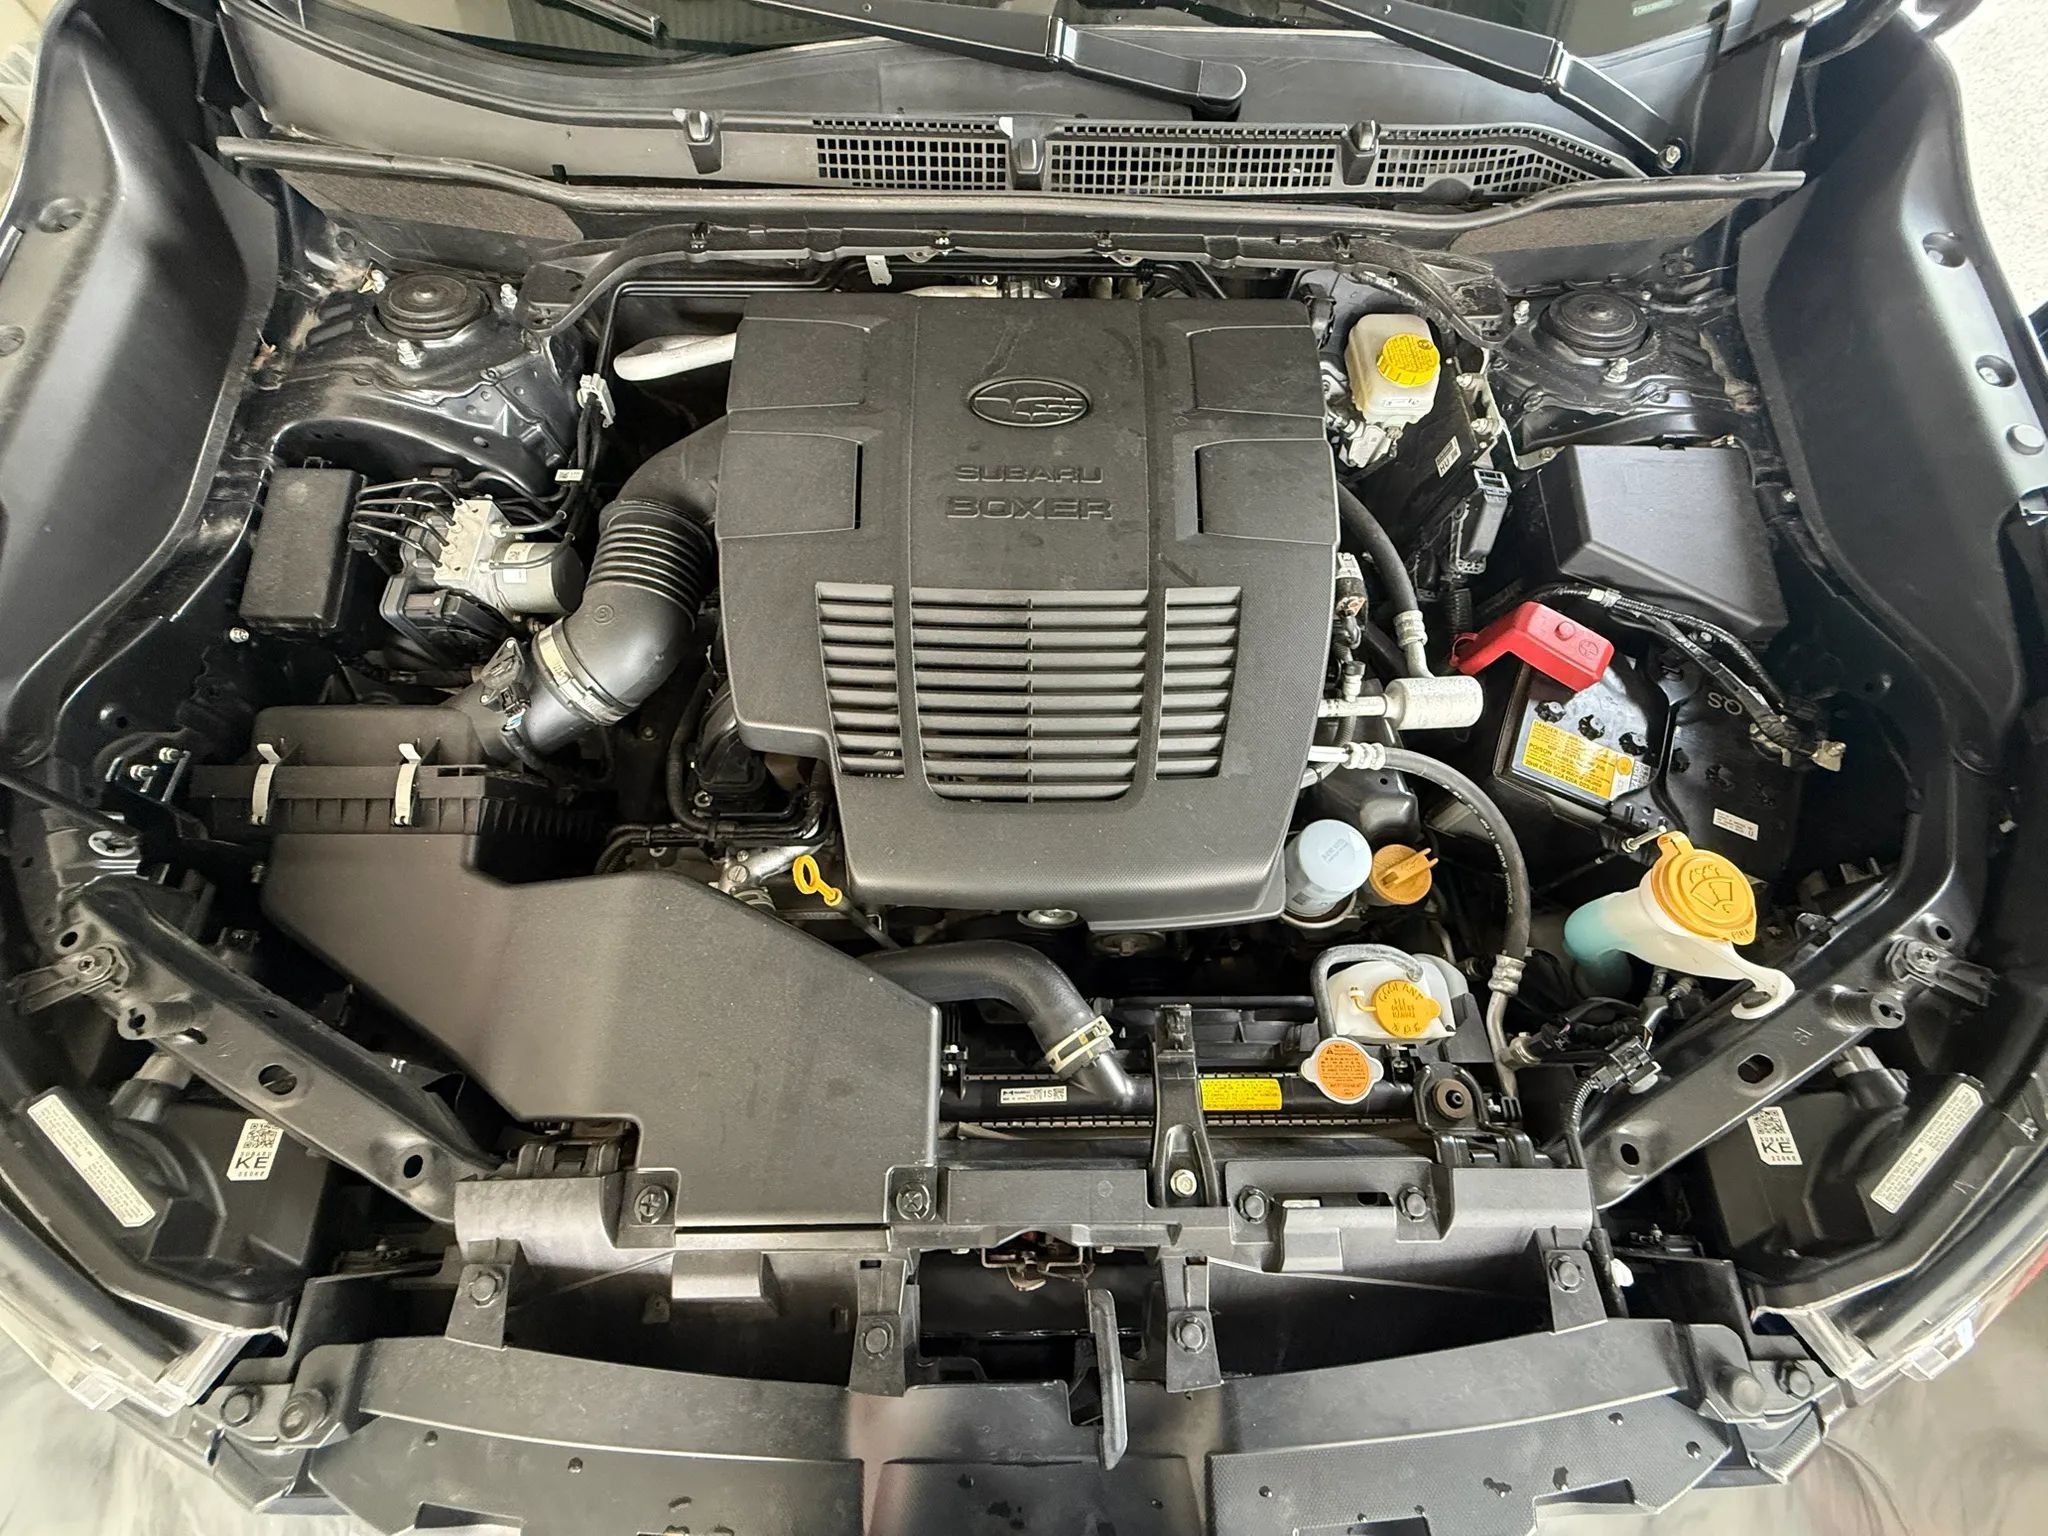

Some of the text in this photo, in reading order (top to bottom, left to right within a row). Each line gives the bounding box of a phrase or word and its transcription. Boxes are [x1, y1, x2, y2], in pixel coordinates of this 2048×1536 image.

[956, 464, 1104, 484] SUBARU
[946, 496, 1114, 521] BOXER
[1761, 1142, 1794, 1154] KE
[235, 1155, 270, 1169] KE
